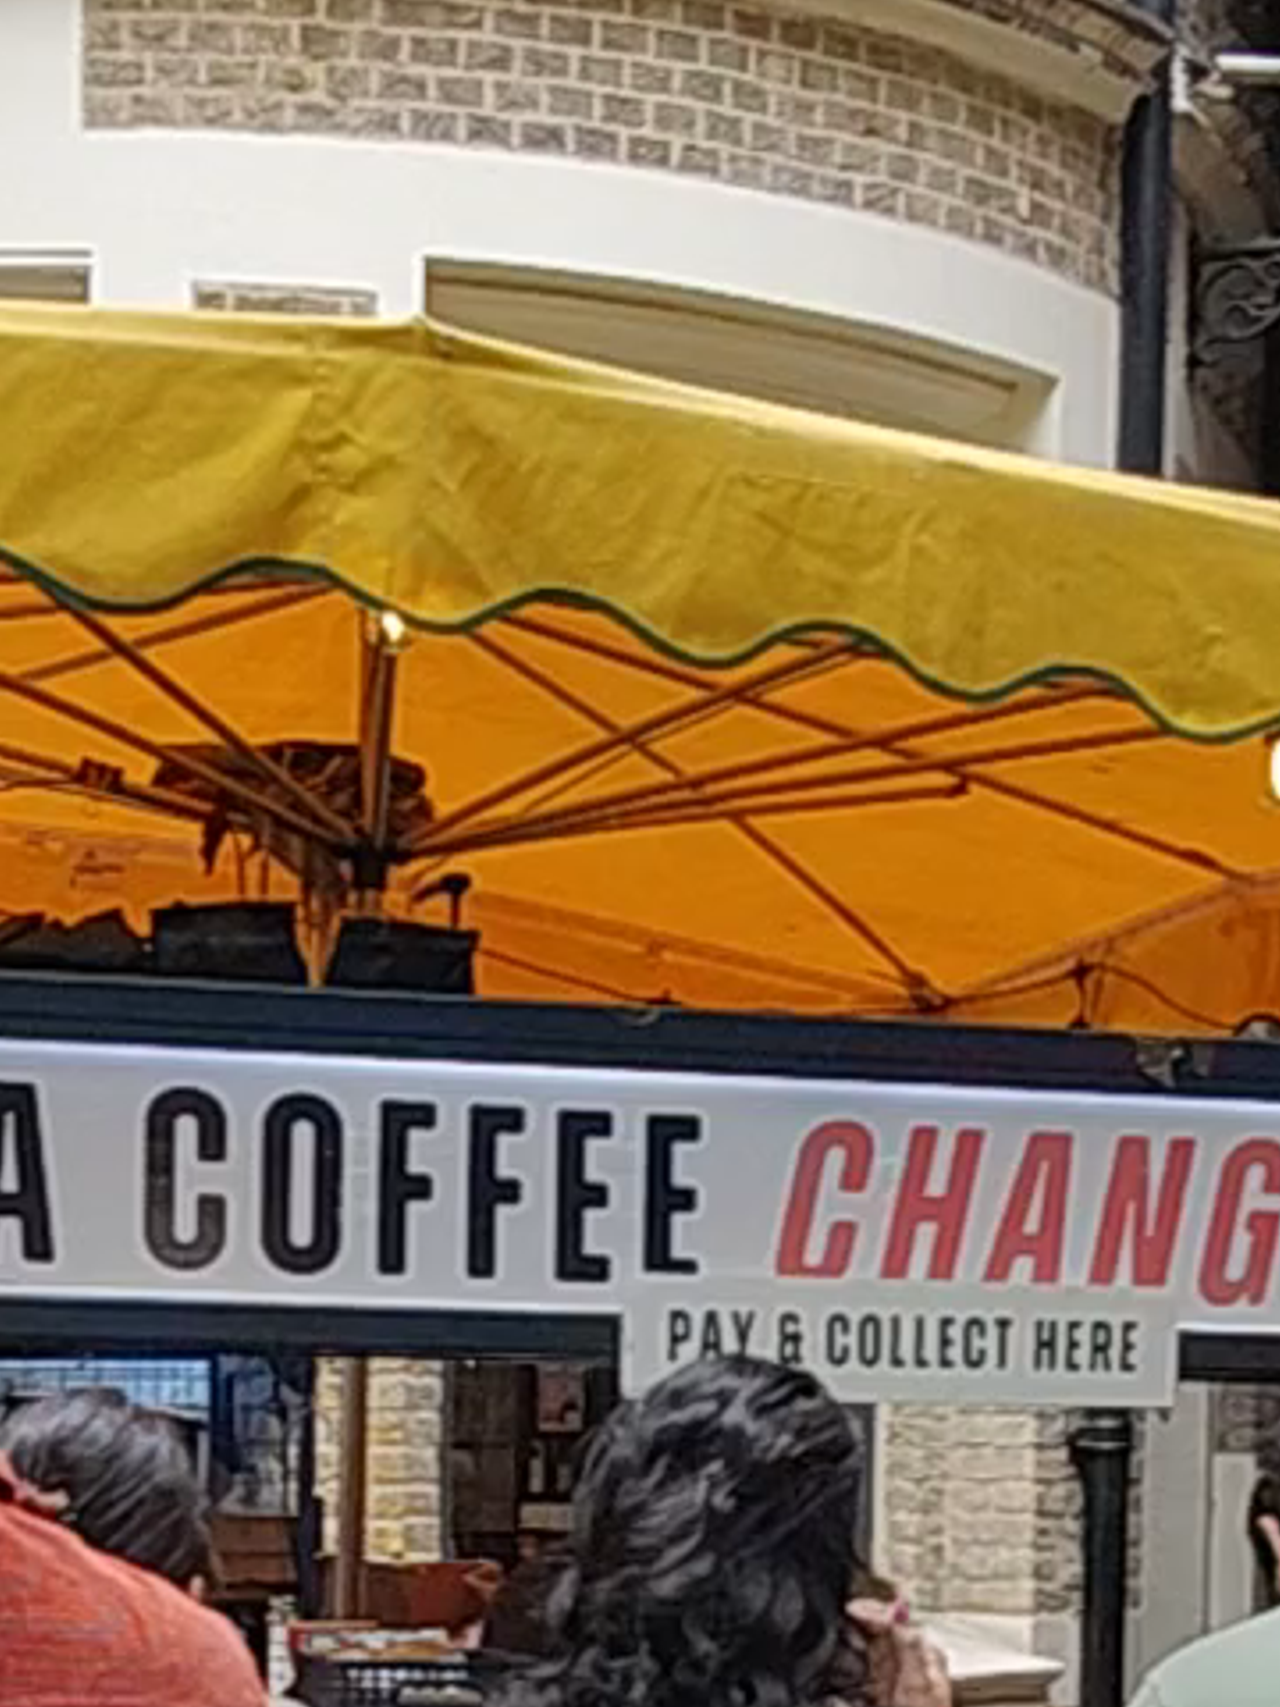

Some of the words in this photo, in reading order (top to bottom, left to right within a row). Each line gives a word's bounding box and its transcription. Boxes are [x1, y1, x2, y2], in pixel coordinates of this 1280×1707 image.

[144, 1086, 702, 1282] COFFEE
[667, 1309, 756, 1361] PAY
[778, 1311, 804, 1365] &
[825, 1311, 1014, 1370] COLLECT
[1032, 1318, 1139, 1373] HERE
